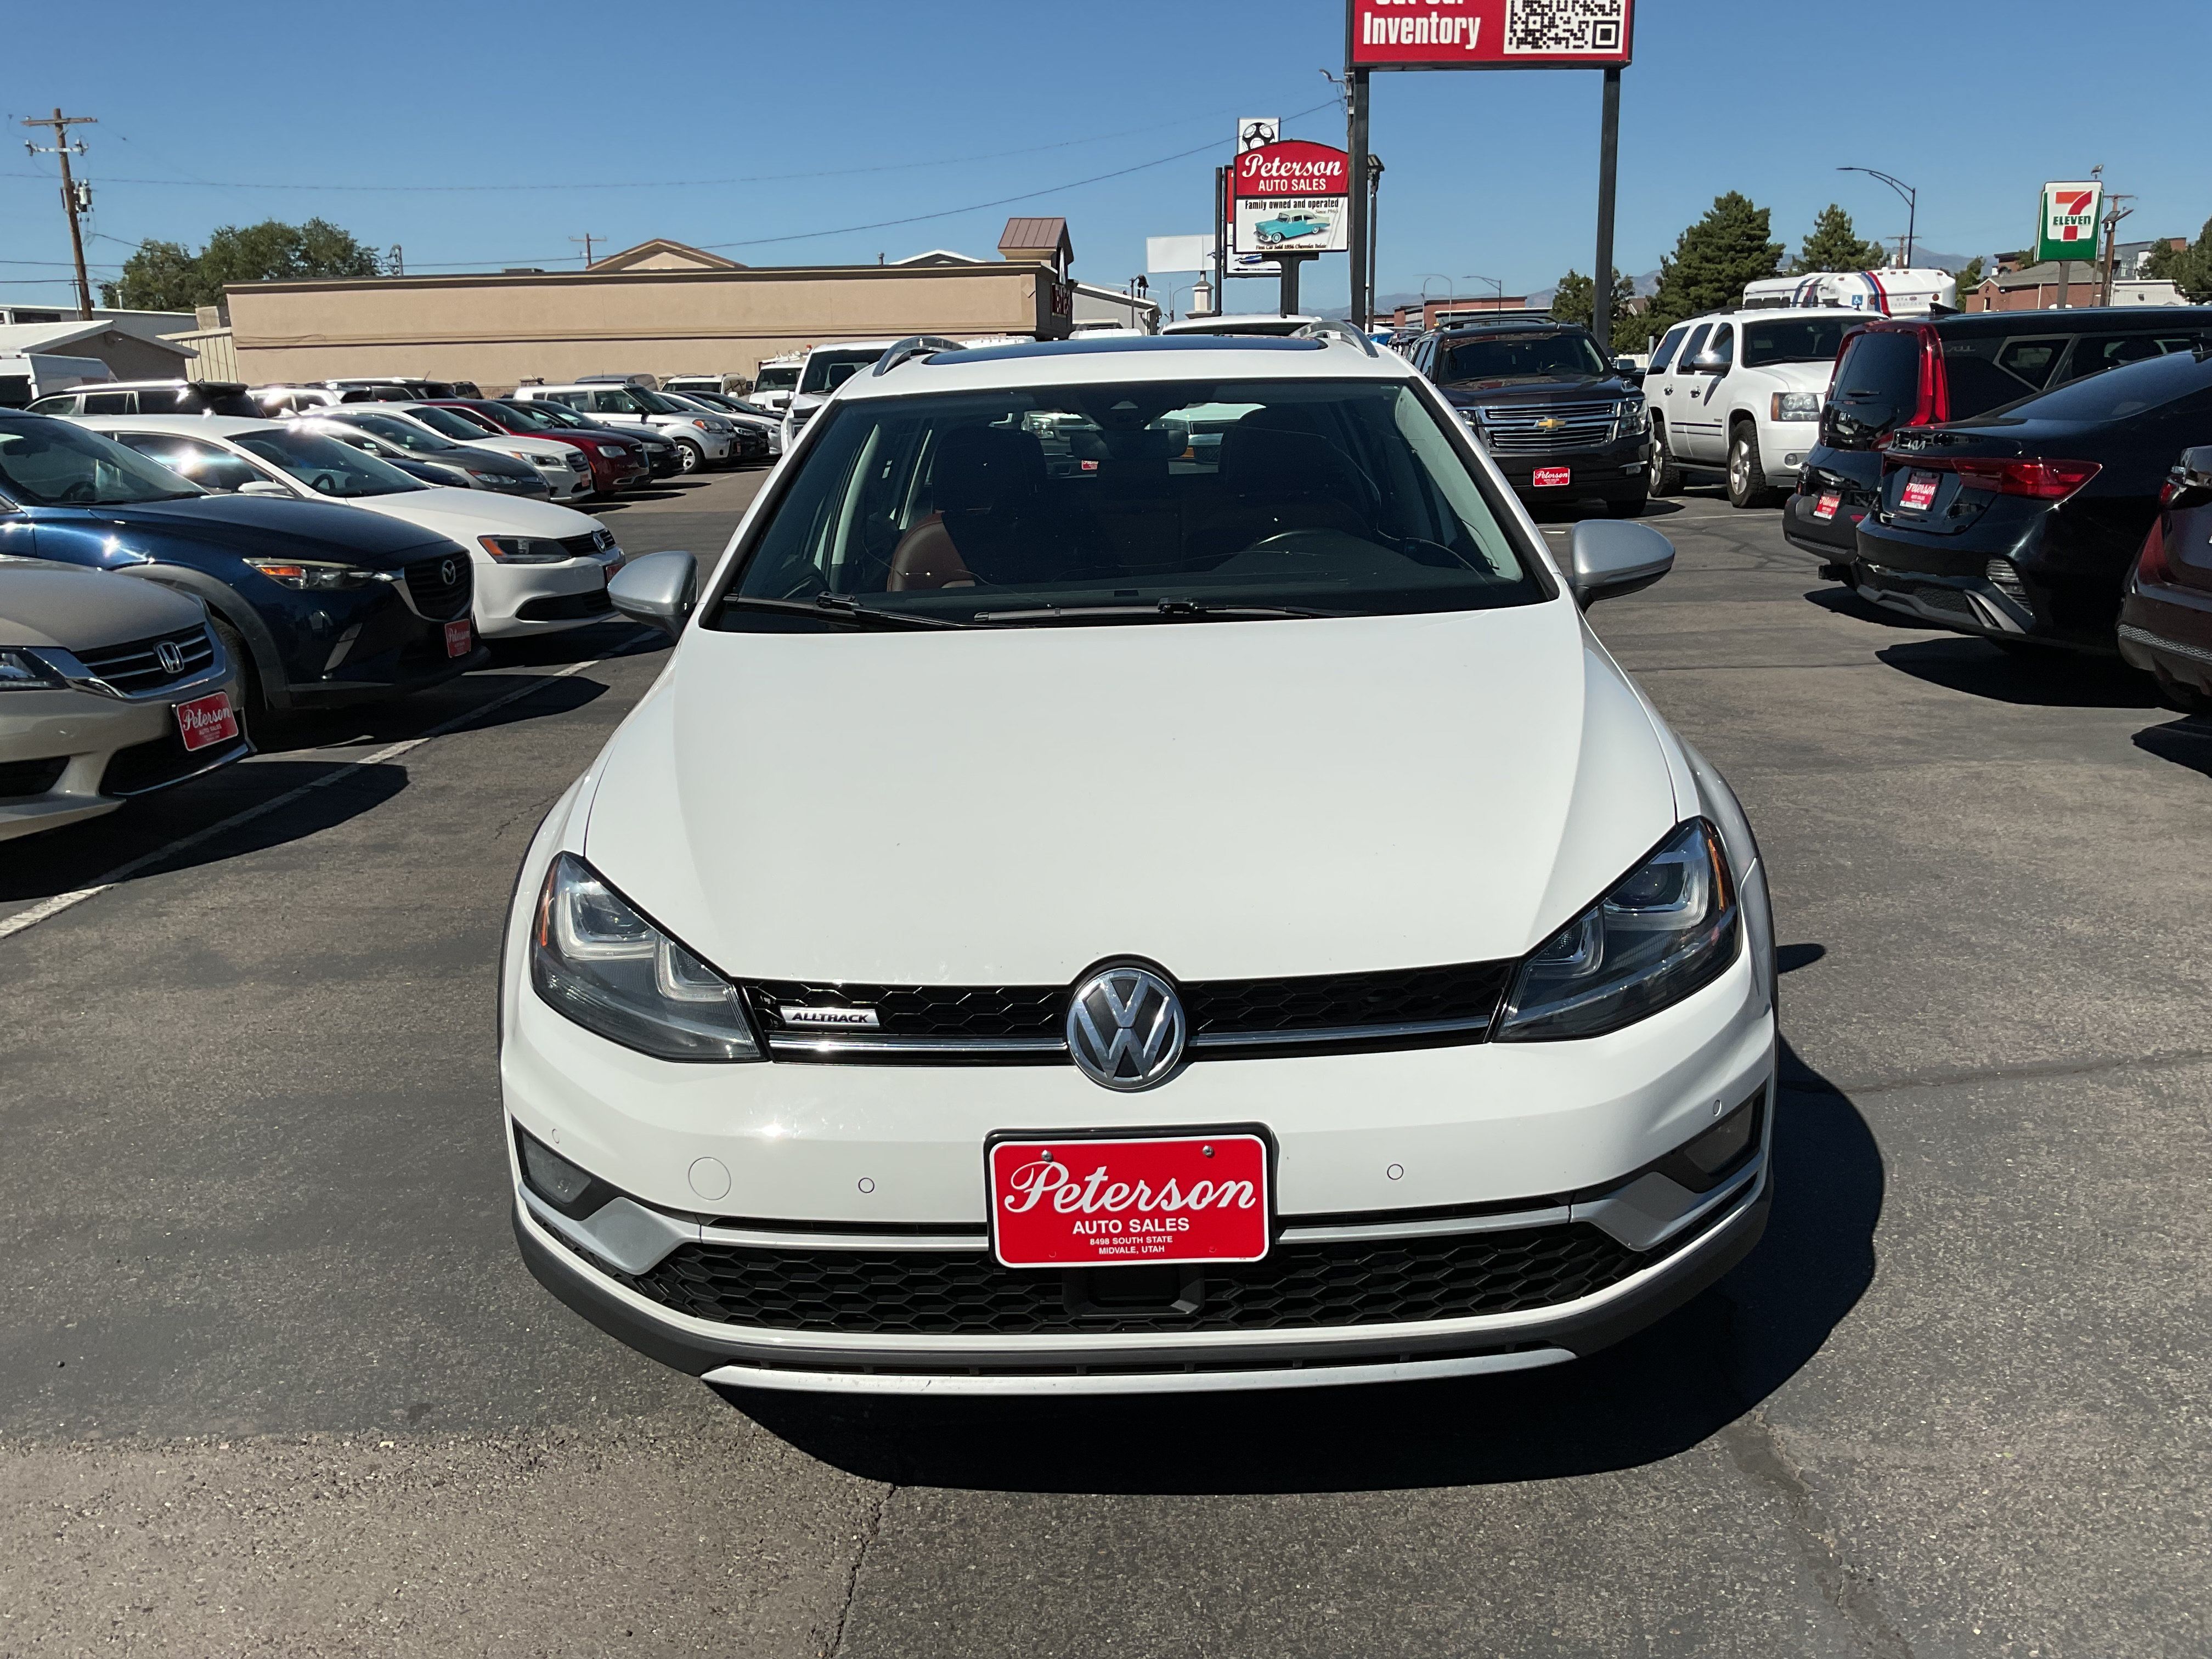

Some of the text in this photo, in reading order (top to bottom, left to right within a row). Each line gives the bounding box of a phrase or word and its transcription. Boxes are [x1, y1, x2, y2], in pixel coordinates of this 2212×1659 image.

[1363, 12, 1481, 50] Inventory
[1242, 154, 1342, 178] Peterson
[1258, 178, 1327, 192] AUTO SALES
[1245, 198, 1339, 211] Family owned and operated
[1535, 470, 1568, 479] Peterson
[182, 707, 230, 731] Peterson
[792, 1012, 869, 1023] ALLTRACK
[1004, 1160, 1256, 1214] Peterson
[1072, 1217, 1190, 1235] AUTO SALES
[1090, 1235, 1173, 1245] 8498 SOUTH STATE
[1098, 1245, 1165, 1255] MIDVALE, UTAH
